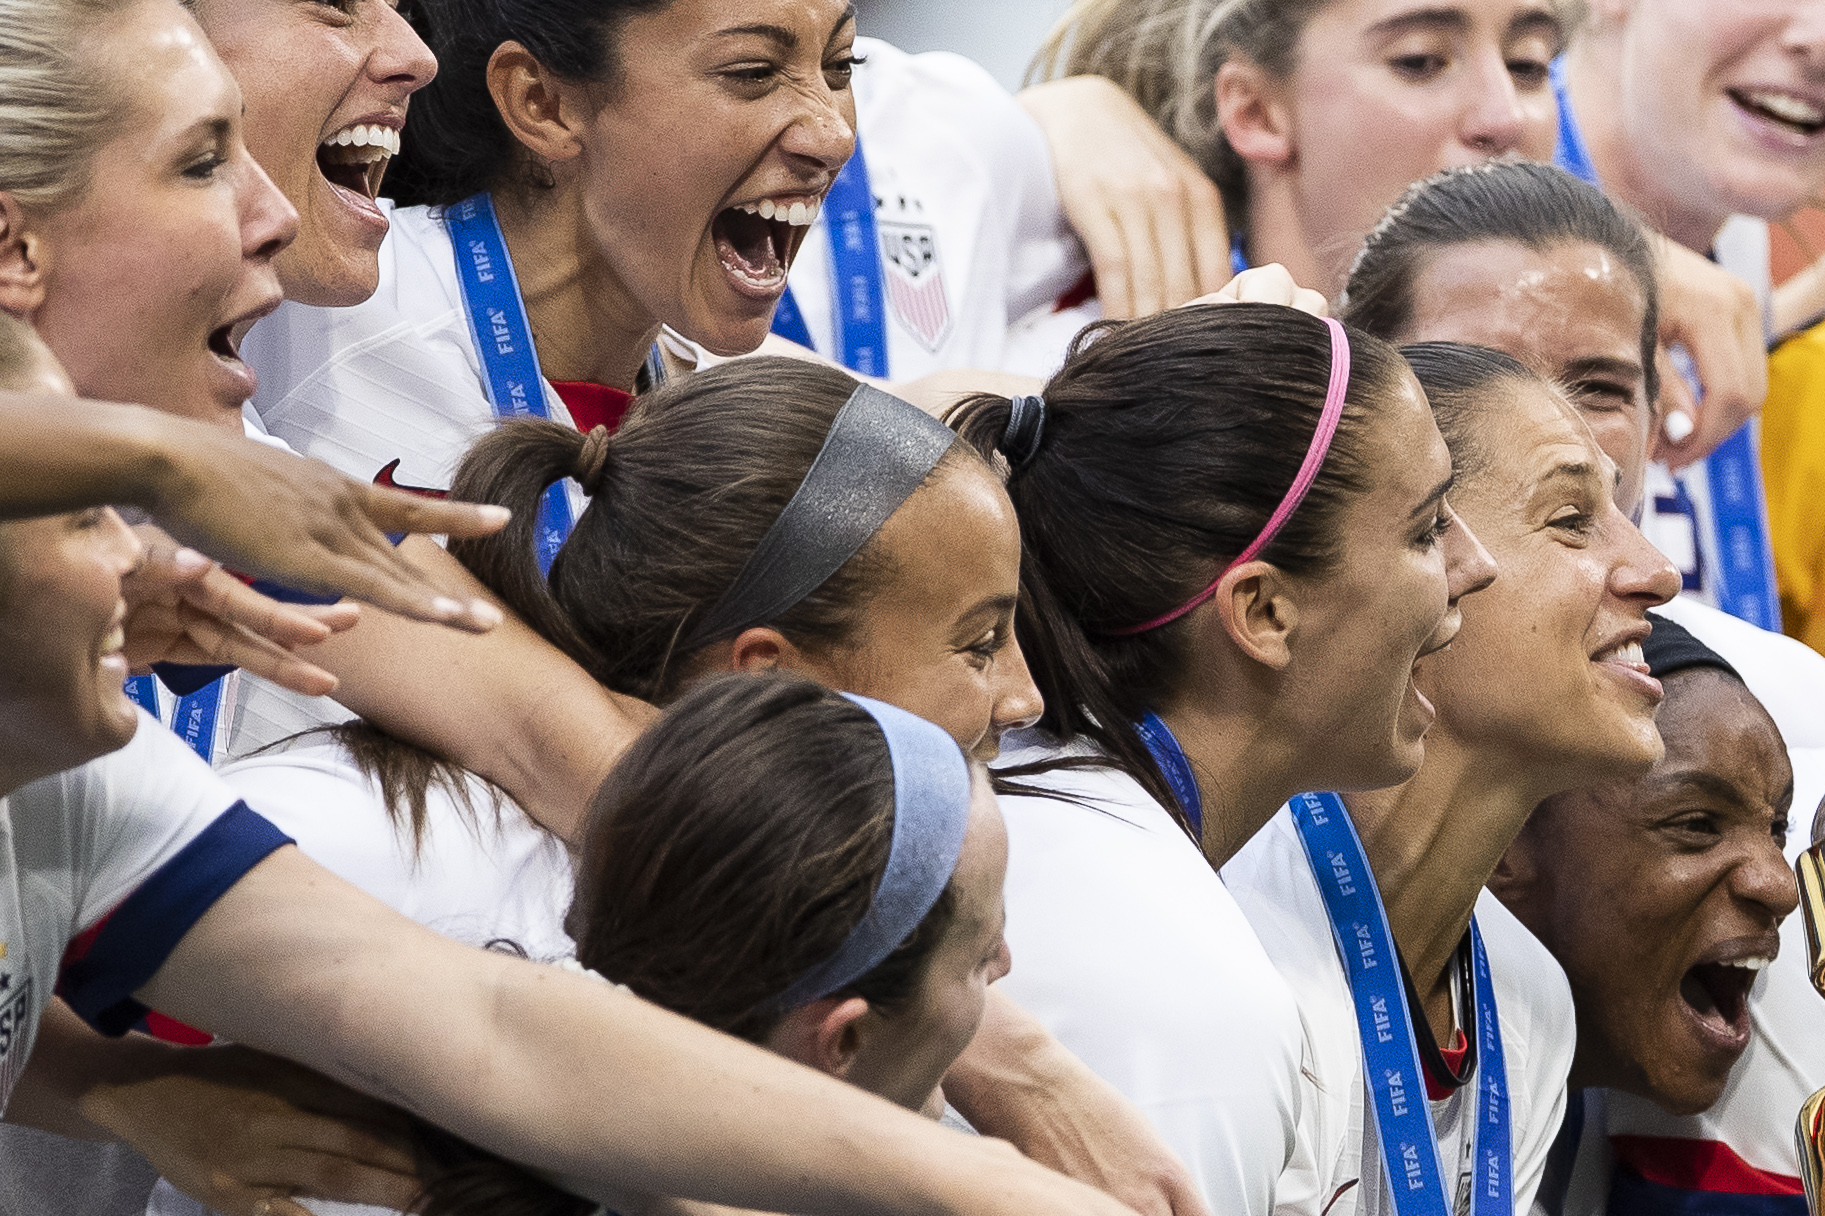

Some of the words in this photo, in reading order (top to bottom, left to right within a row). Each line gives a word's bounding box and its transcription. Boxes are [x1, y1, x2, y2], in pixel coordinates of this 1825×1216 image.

[511, 383, 529, 415] IFA
[1331, 853, 1356, 897] FIFA
[1357, 924, 1378, 970] FIFA
[1372, 997, 1394, 1044] FIFA
[1389, 1071, 1408, 1117] FIFA
[1402, 1144, 1424, 1190] FIFA
